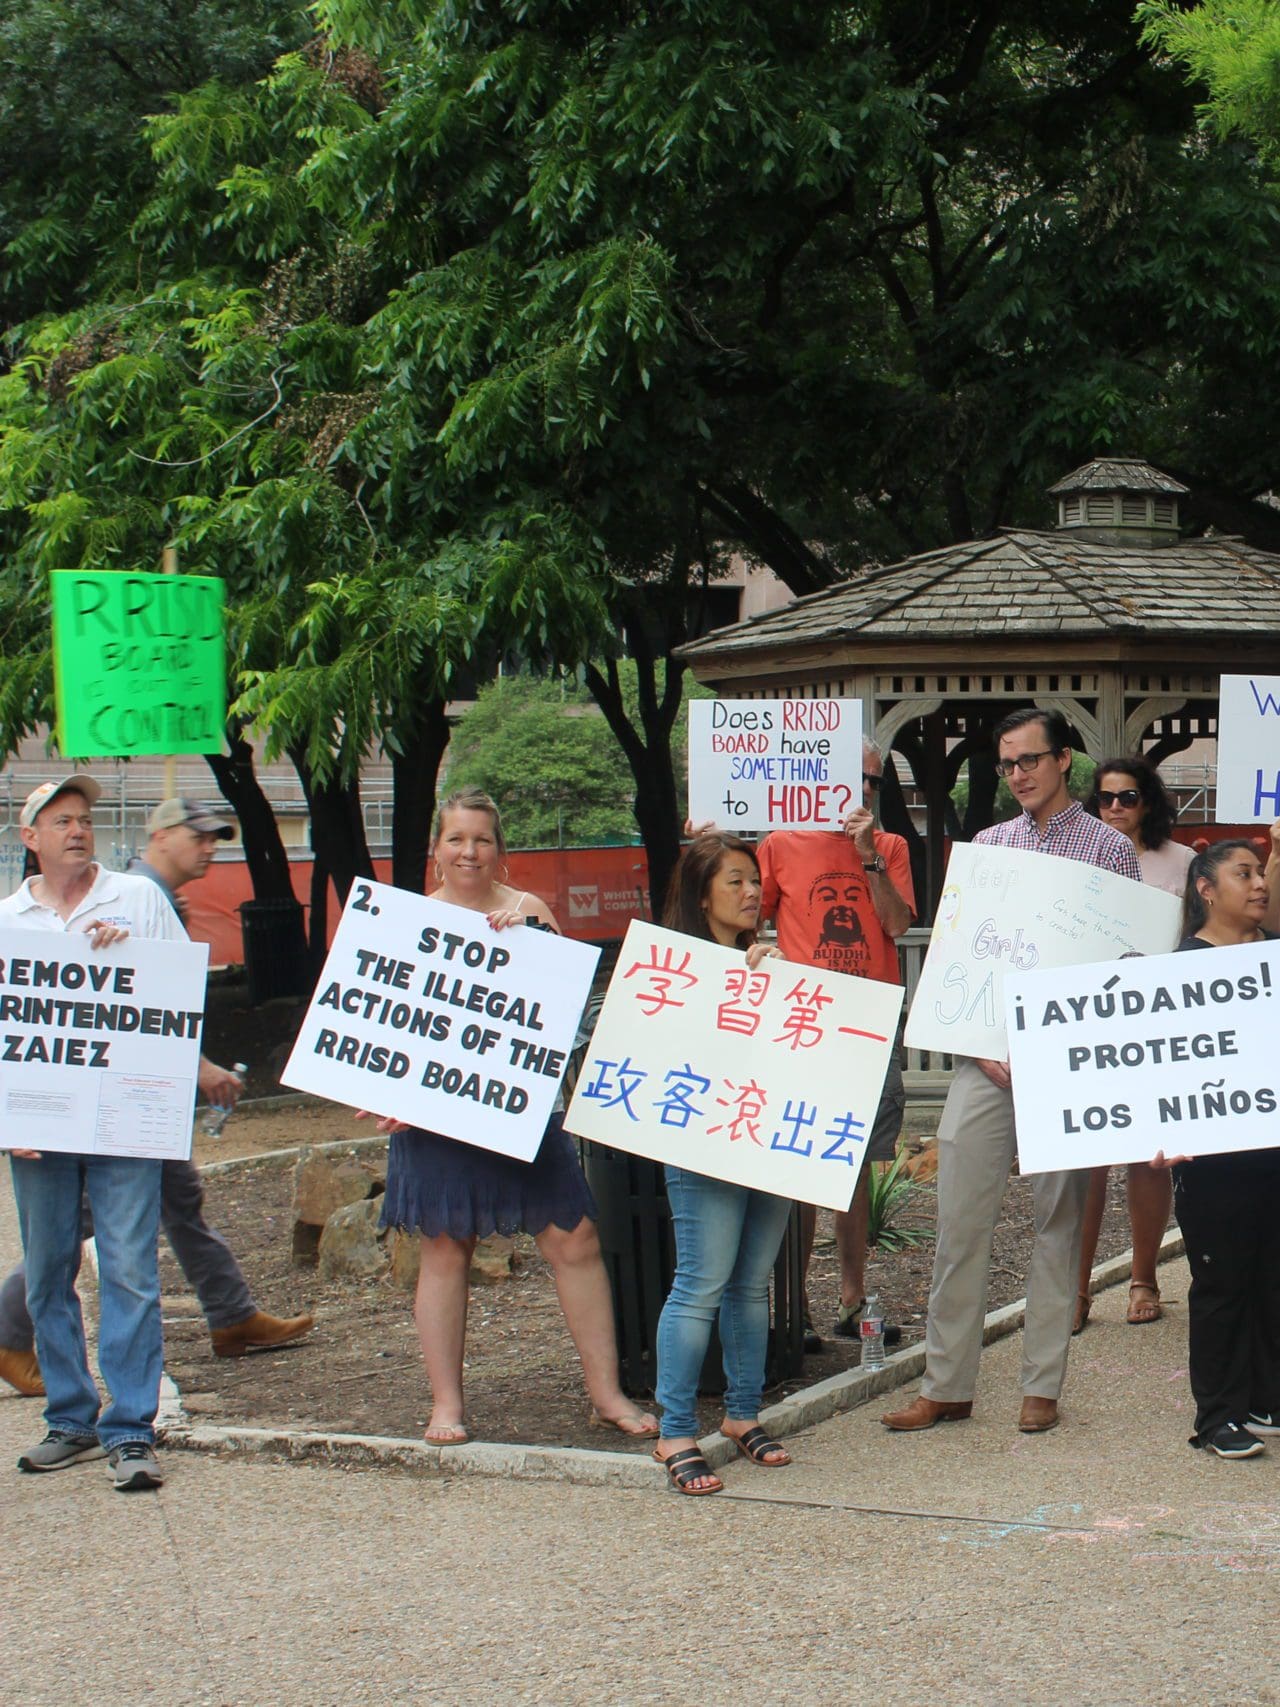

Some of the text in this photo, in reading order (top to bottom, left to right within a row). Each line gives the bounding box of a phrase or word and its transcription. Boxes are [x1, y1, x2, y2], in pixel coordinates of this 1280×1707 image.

[712, 700, 841, 732] Does RRISD
[712, 732, 831, 756] BOARD have
[731, 757, 828, 782] SOMETHING
[722, 784, 852, 825] to HIDE?
[351, 884, 381, 916] 2.
[417, 927, 511, 974] STOP
[813, 948, 872, 961] BUDDHA
[828, 959, 860, 968] IS MY
[0, 958, 136, 995] EMOVE
[356, 948, 544, 1031] THE ILLEGAL
[317, 981, 566, 1079] ACTIONS OF THE
[2, 1035, 111, 1068] ZAIEZ
[1068, 1030, 1239, 1072] PROTEGE
[313, 1028, 529, 1115] RRISD BOARD
[1063, 1078, 1278, 1134] LOS NIÑOS
